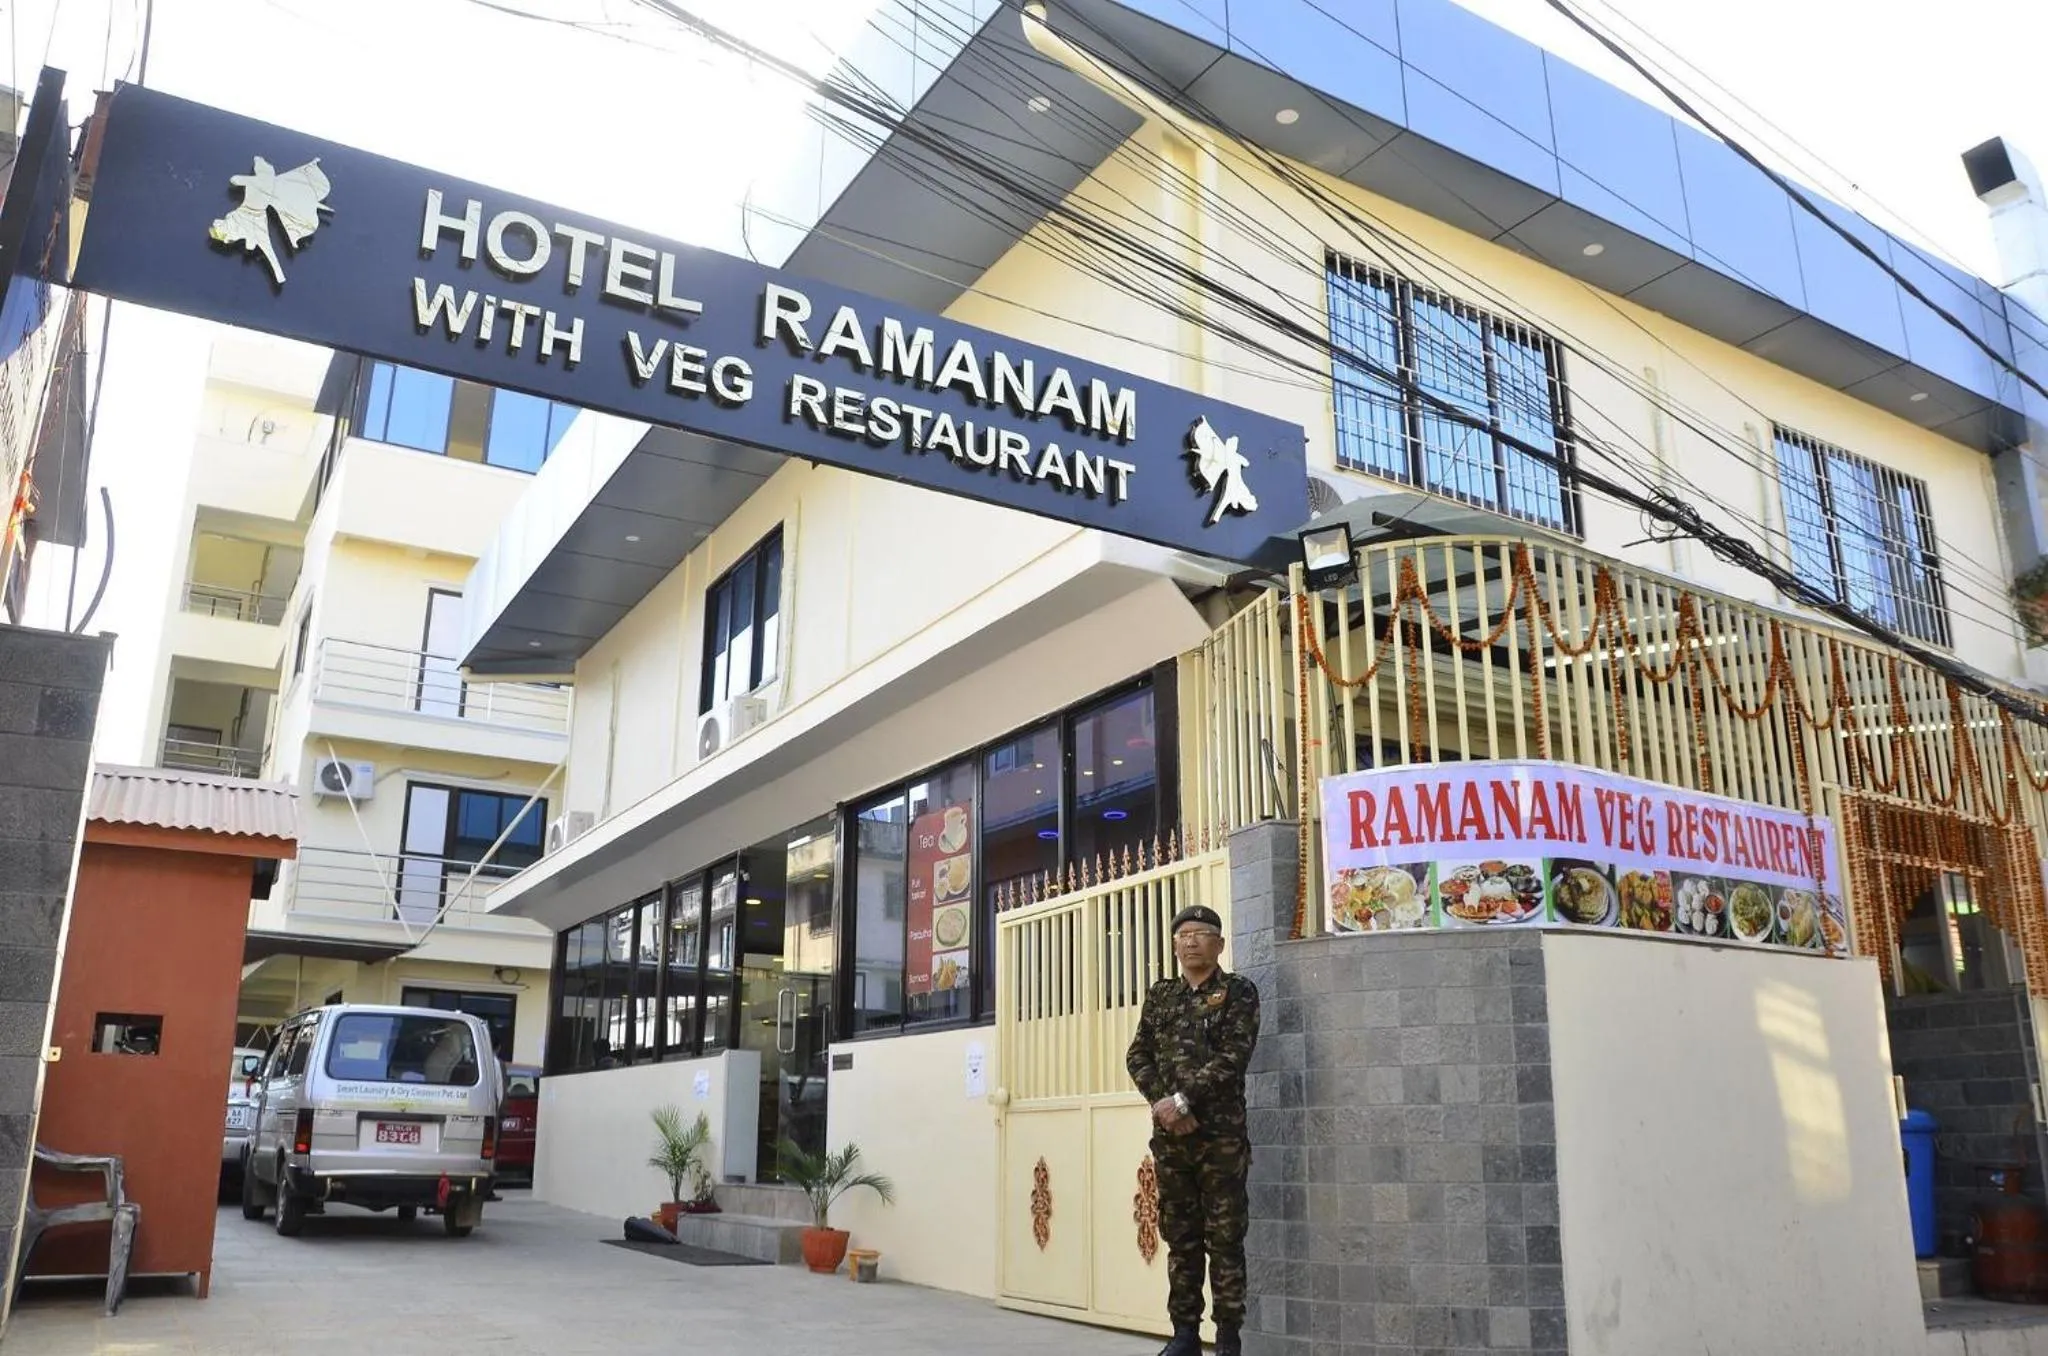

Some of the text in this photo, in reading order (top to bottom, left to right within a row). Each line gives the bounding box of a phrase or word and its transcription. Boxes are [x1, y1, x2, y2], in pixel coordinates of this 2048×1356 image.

[421, 188, 1136, 441] HOTEL RAMANAM
[626, 330, 753, 402] VEG
[790, 373, 1136, 501] RESTAURANT
[920, 834, 934, 849] Tea
[1347, 780, 1827, 881] RAMANAM VEG RESTAURENT
[360, 1085, 389, 1097] Laundry
[390, 1087, 396, 1095] &
[397, 1087, 410, 1098] Dry
